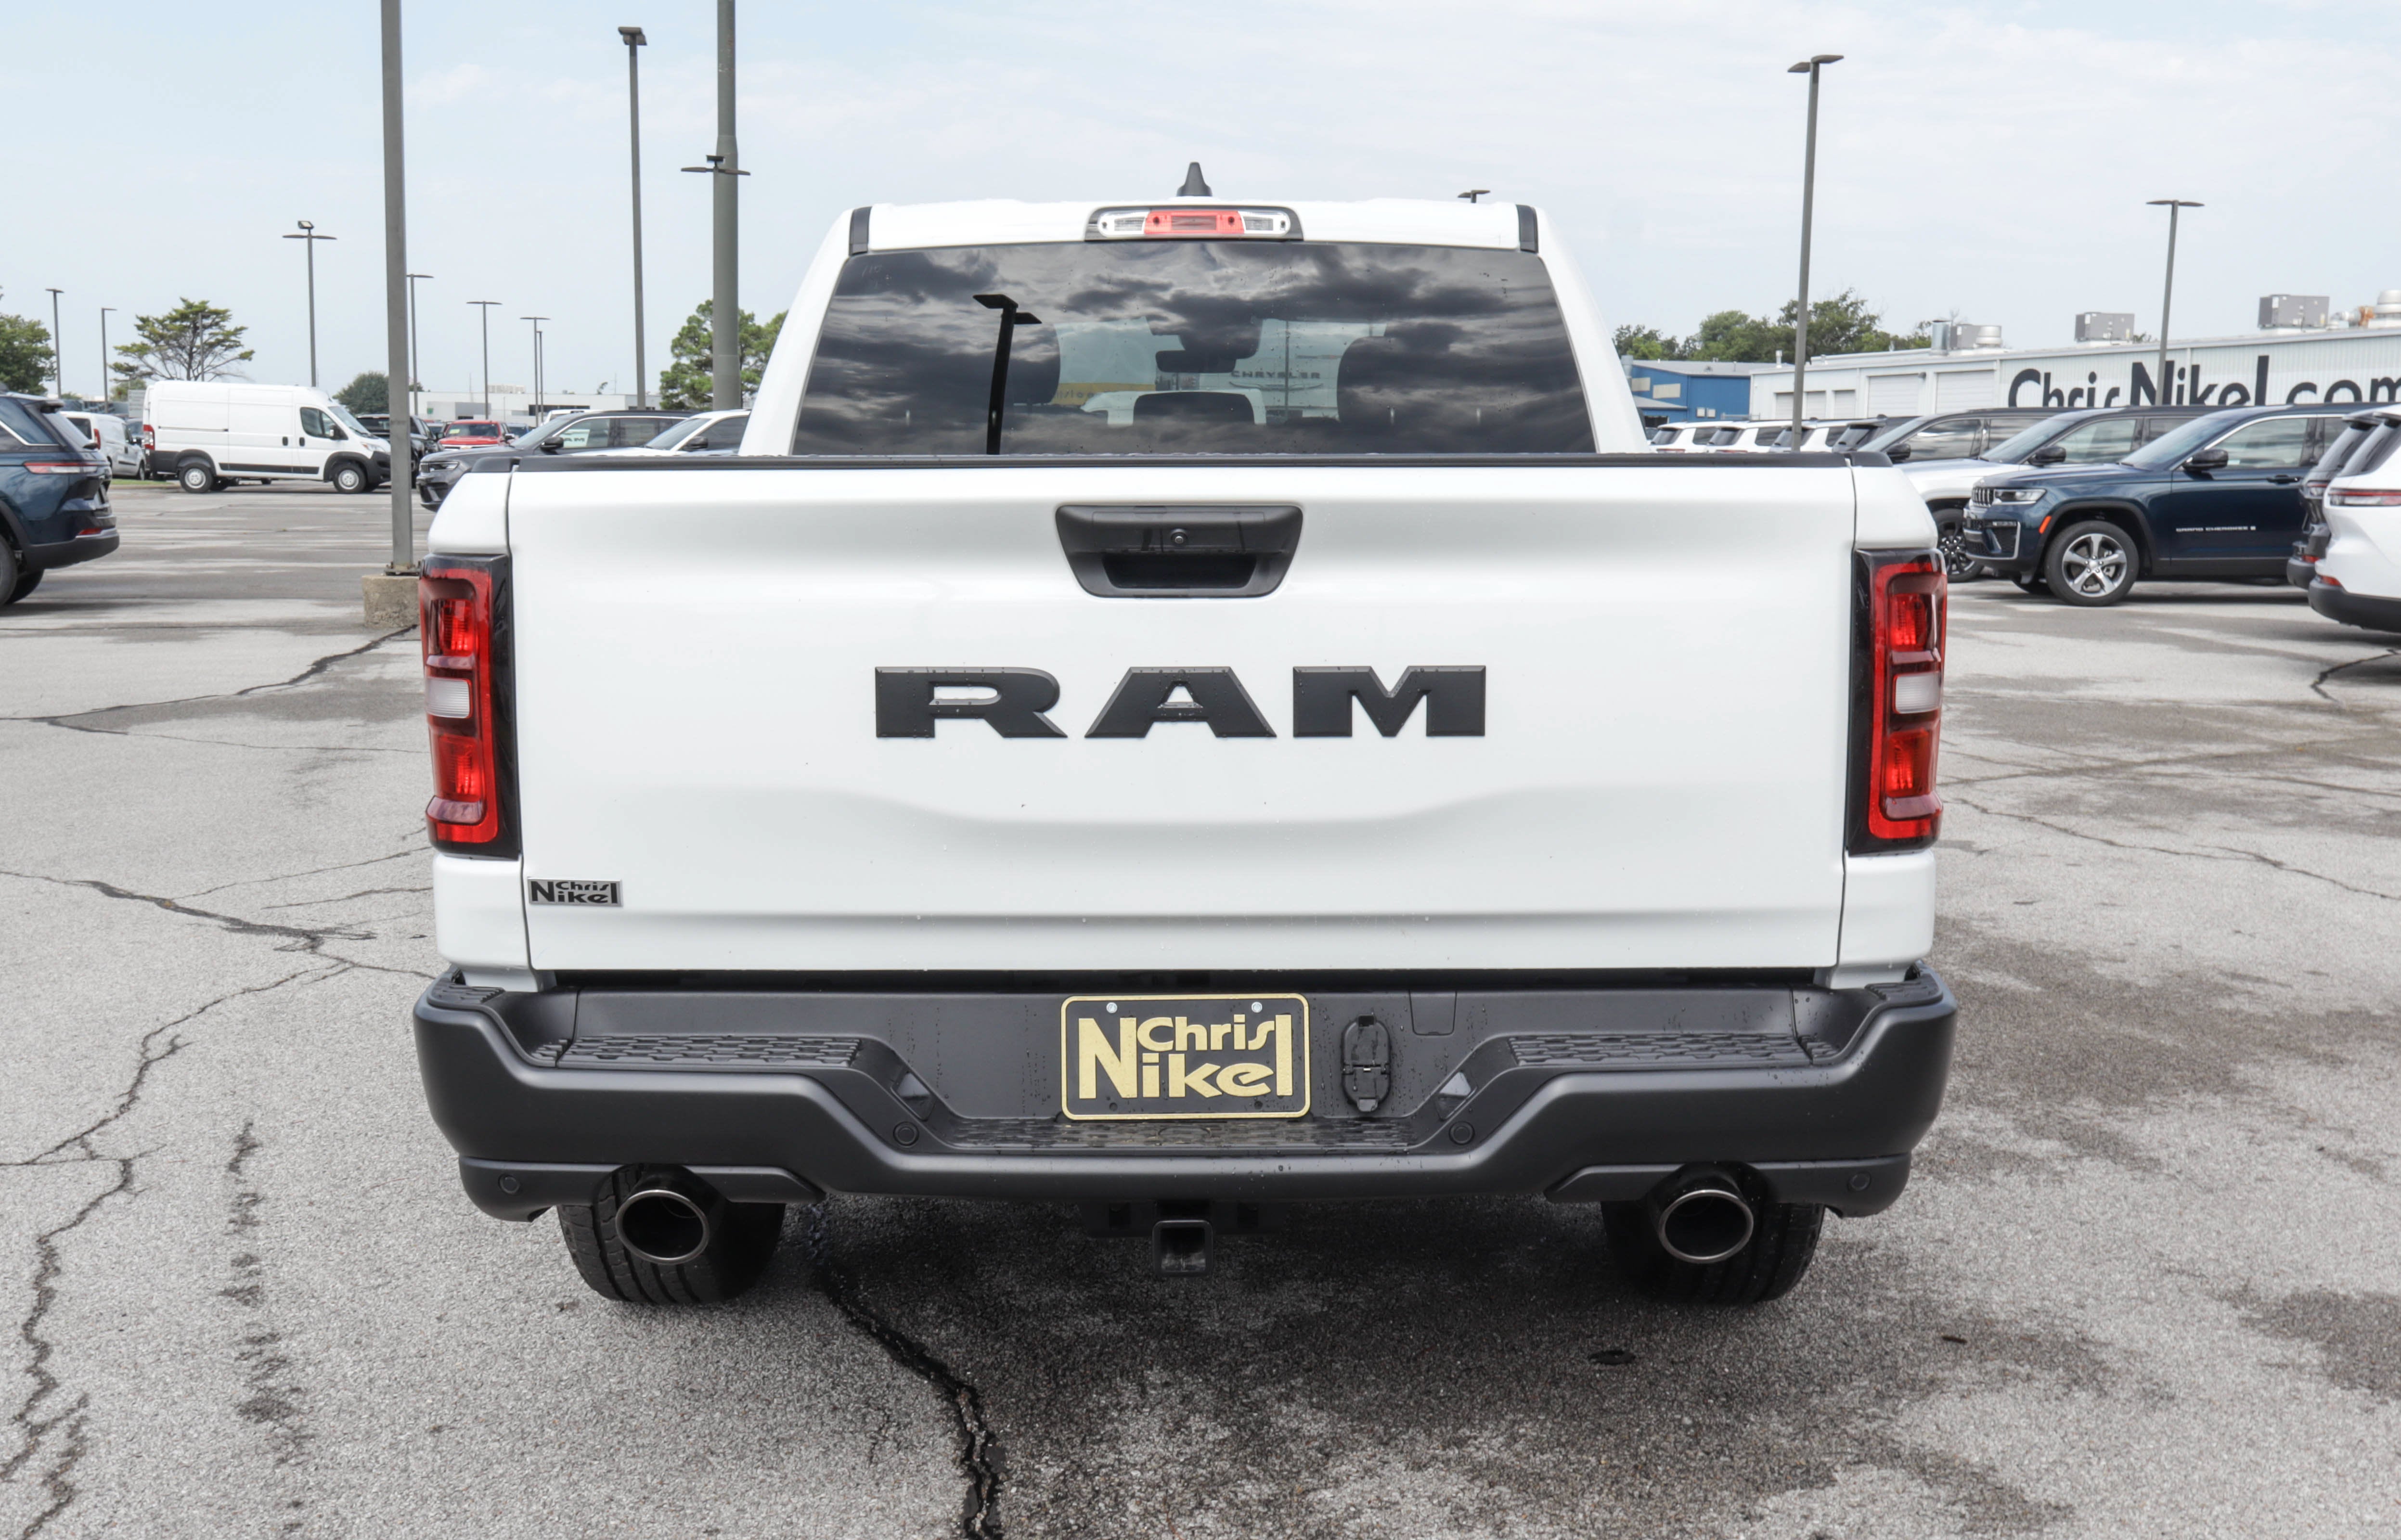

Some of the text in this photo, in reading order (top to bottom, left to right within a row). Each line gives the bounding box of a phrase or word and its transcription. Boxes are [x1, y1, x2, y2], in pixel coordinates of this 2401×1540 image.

[875, 667, 1486, 738] RAM
[531, 881, 618, 904] Nikel
[555, 881, 609, 891] Chris
[1137, 1014, 1275, 1052] Chris
[1078, 1014, 1293, 1099] Nikel
